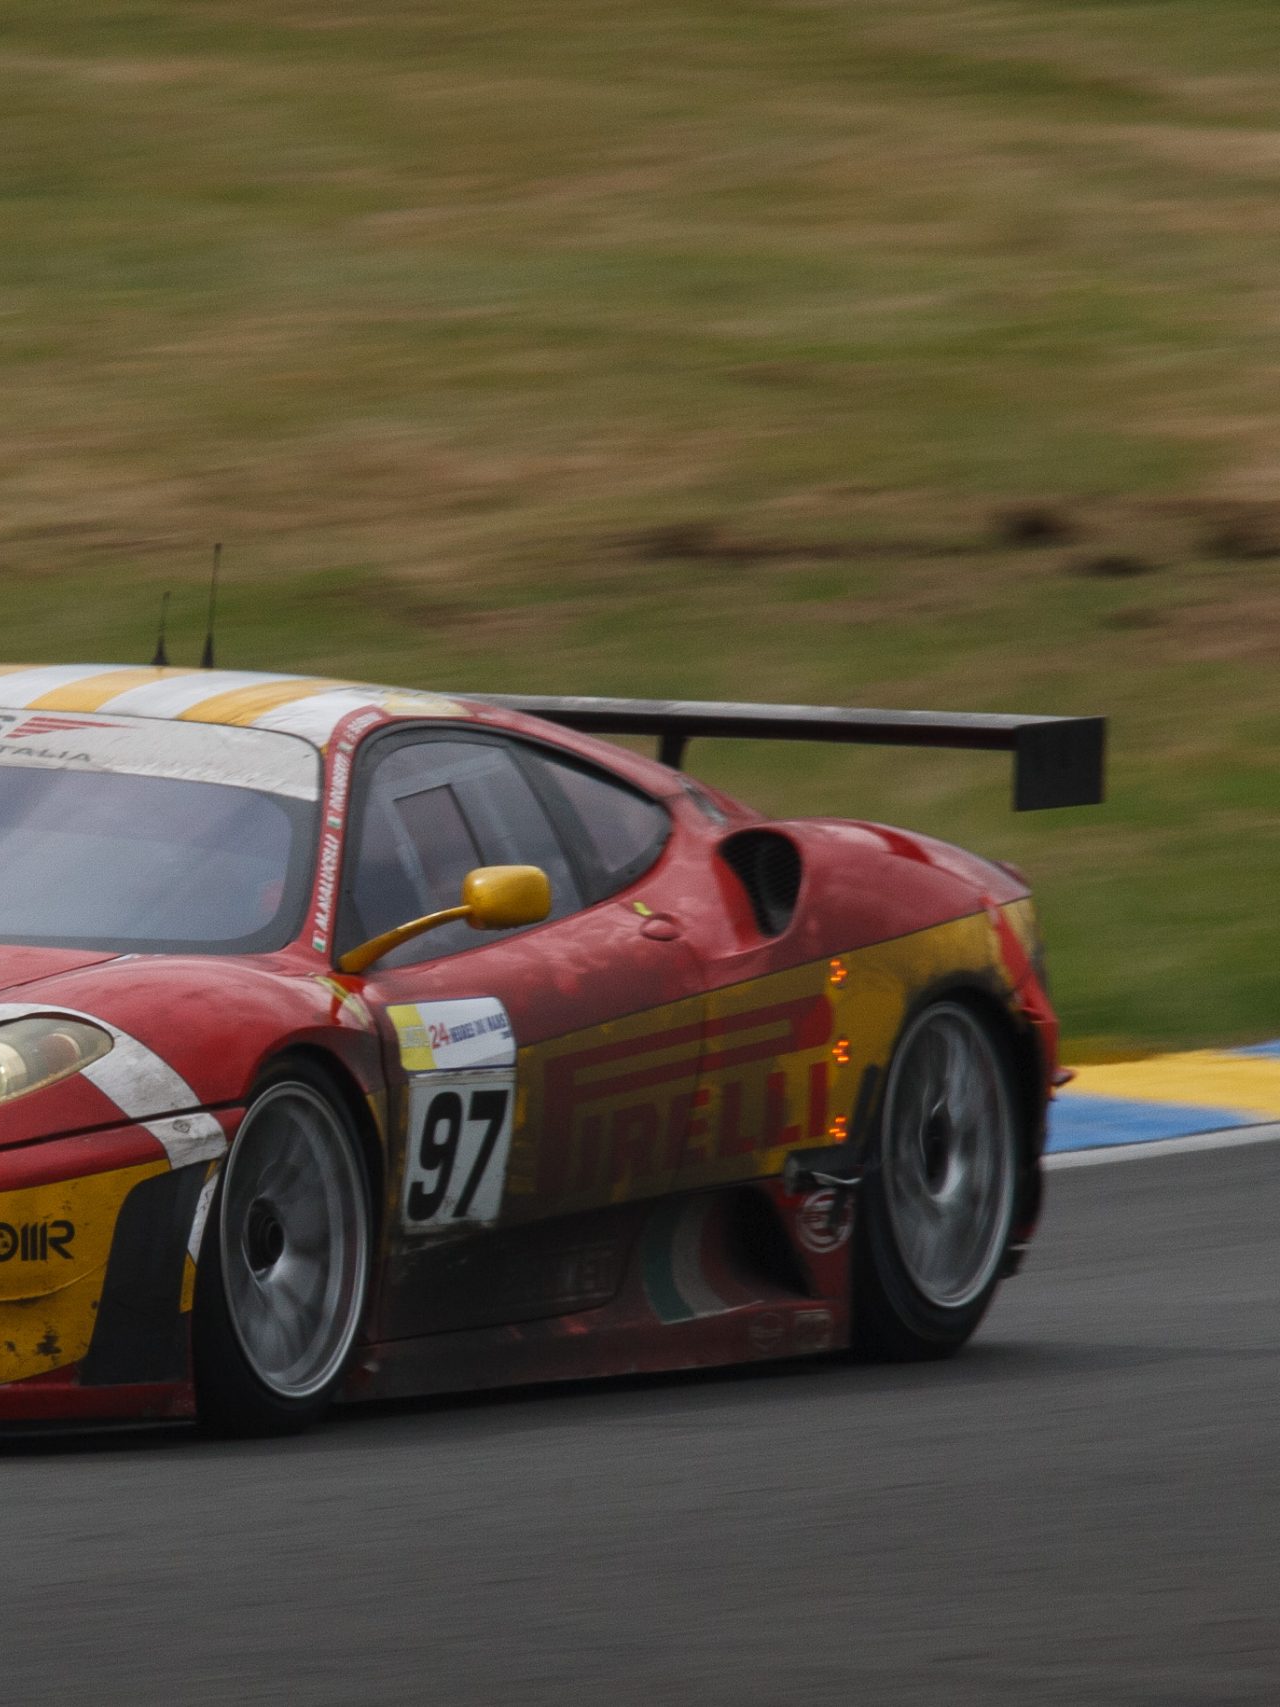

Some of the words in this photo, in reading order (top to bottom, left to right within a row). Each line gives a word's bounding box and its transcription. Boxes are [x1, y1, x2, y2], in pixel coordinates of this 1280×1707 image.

[428, 1022, 450, 1049] 24
[541, 993, 831, 1197] PIRELLI
[406, 1090, 509, 1221] 97
